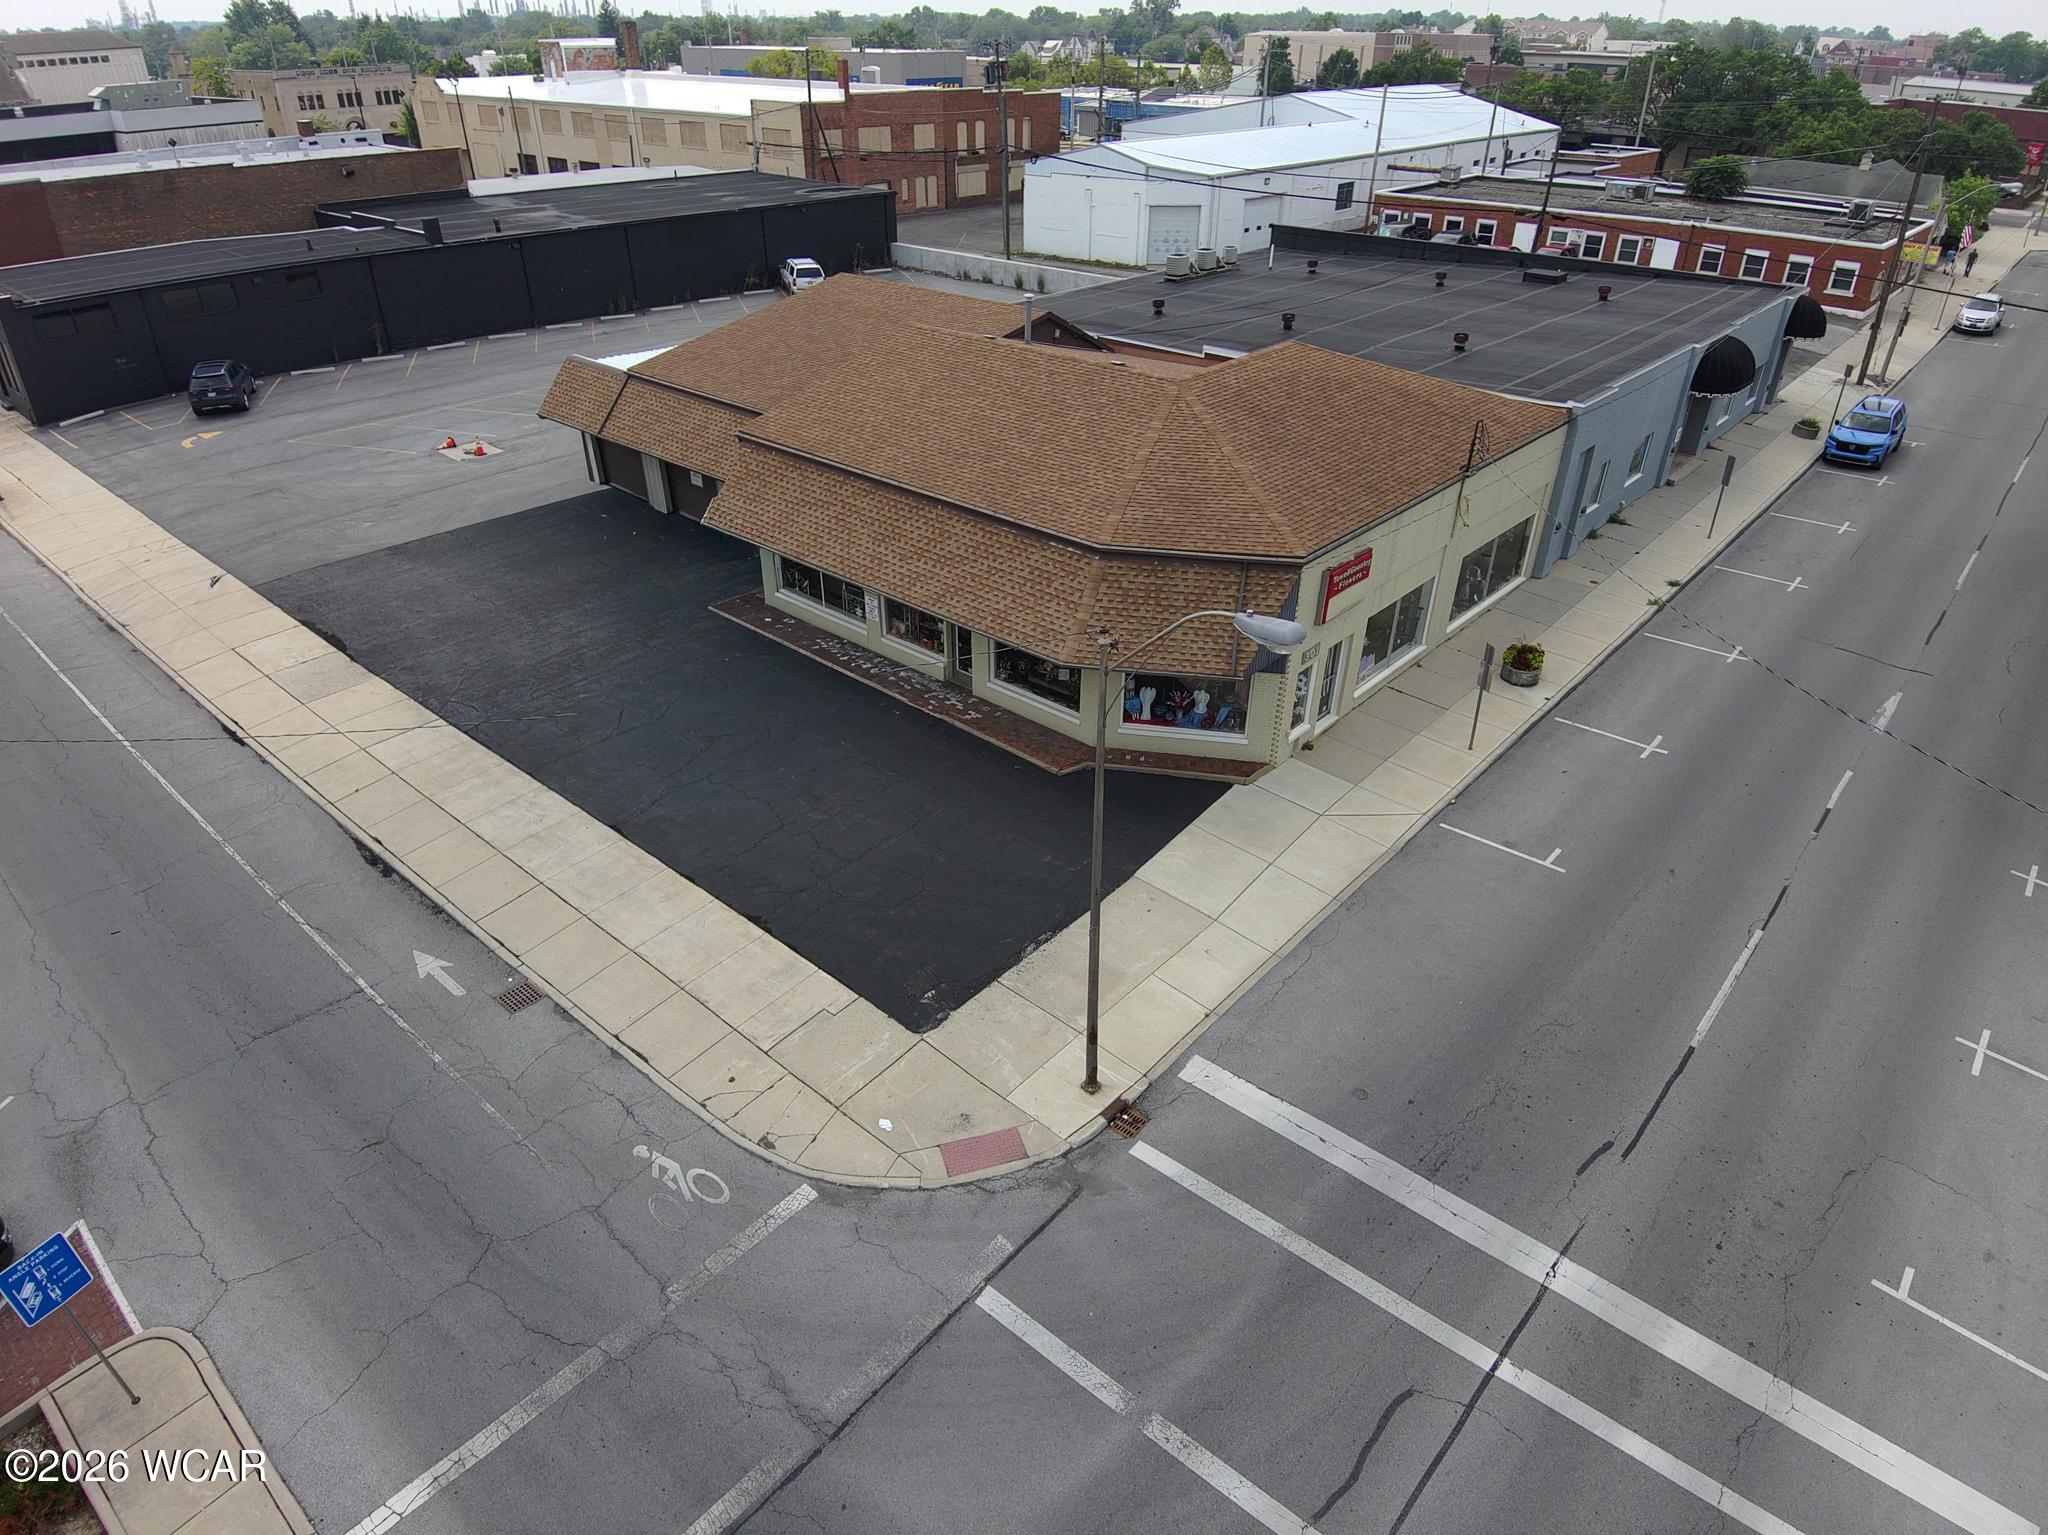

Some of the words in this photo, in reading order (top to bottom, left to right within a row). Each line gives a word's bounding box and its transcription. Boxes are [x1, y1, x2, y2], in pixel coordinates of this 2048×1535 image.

[1338, 572, 1363, 590] Flowers
[8, 1266, 30, 1283] ANGLE
[31, 1245, 59, 1266] PARKING
[17, 1250, 44, 1270] BACK-IN
